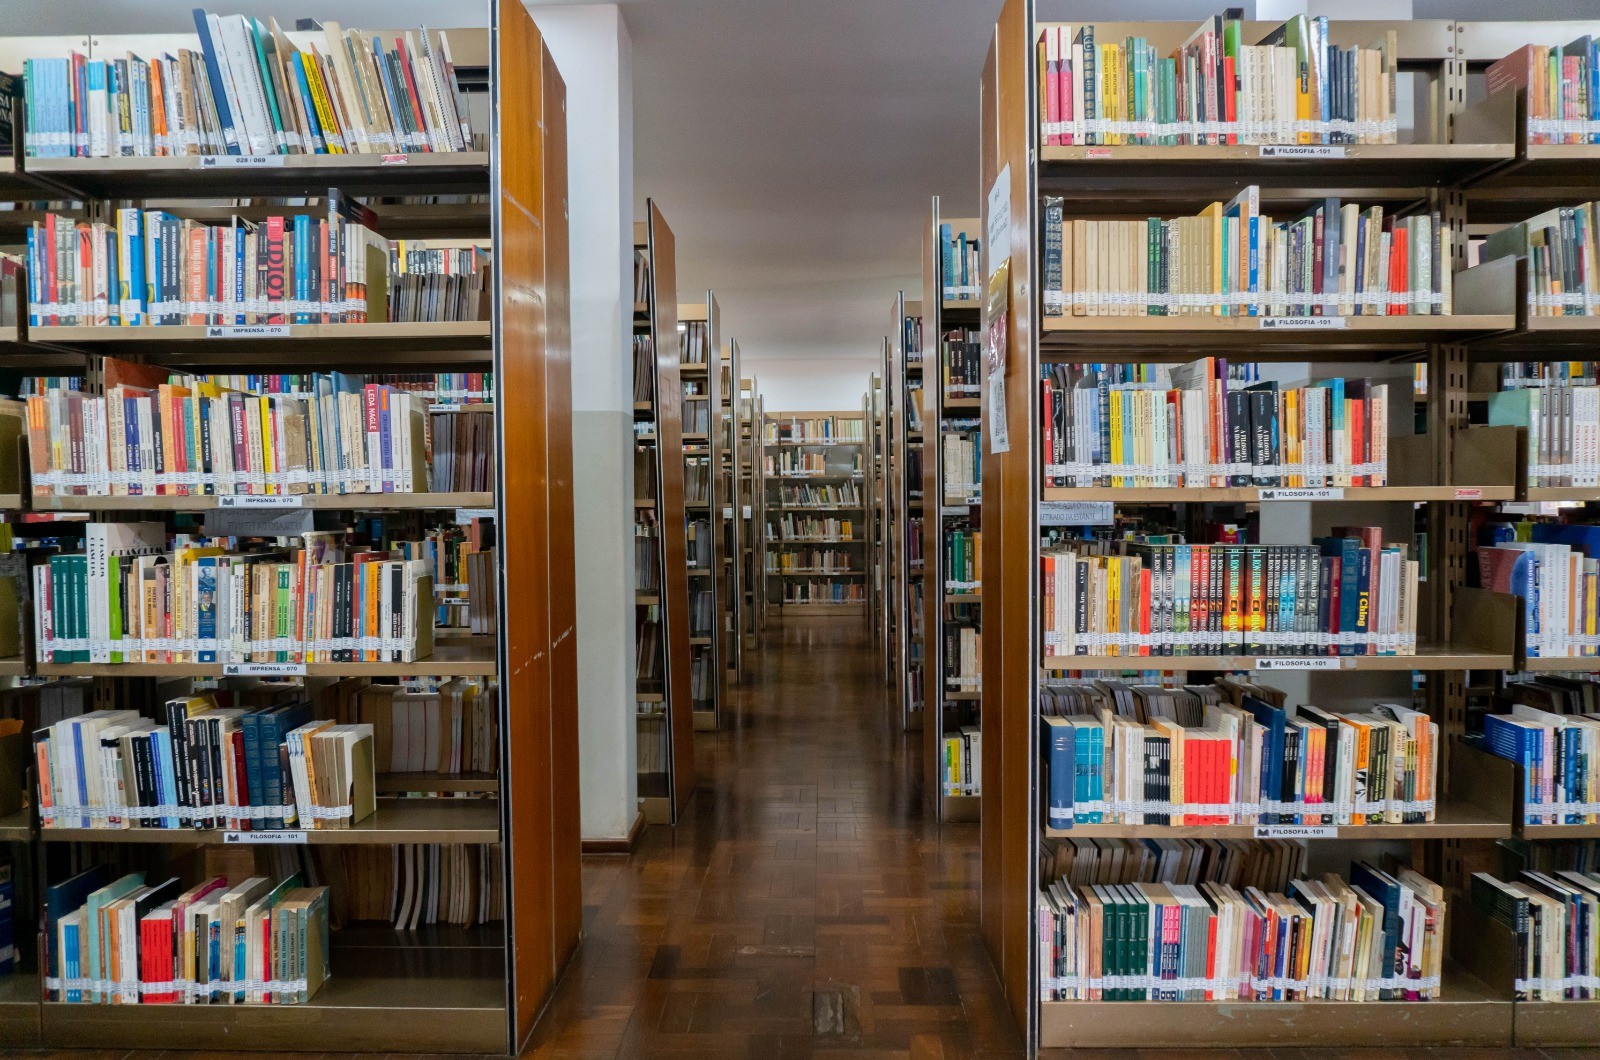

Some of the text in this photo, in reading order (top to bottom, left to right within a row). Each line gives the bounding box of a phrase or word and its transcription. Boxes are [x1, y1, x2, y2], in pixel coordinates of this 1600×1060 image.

[192, 274, 201, 300] IMPRENSA
[367, 389, 378, 430] LEDA NAGLE
[234, 406, 243, 445] atualidades
[1066, 513, 1073, 521] DA
[1074, 513, 1096, 521] ESTANTE
[1230, 559, 1239, 571] RON
[1251, 559, 1261, 571] RON
[1310, 559, 1318, 571] RON
[1230, 571, 1239, 598] HUBBARD
[1251, 571, 1261, 598] HUBBARD
[1310, 571, 1318, 598] HUBBARD
[1357, 597, 1368, 627] Ching
